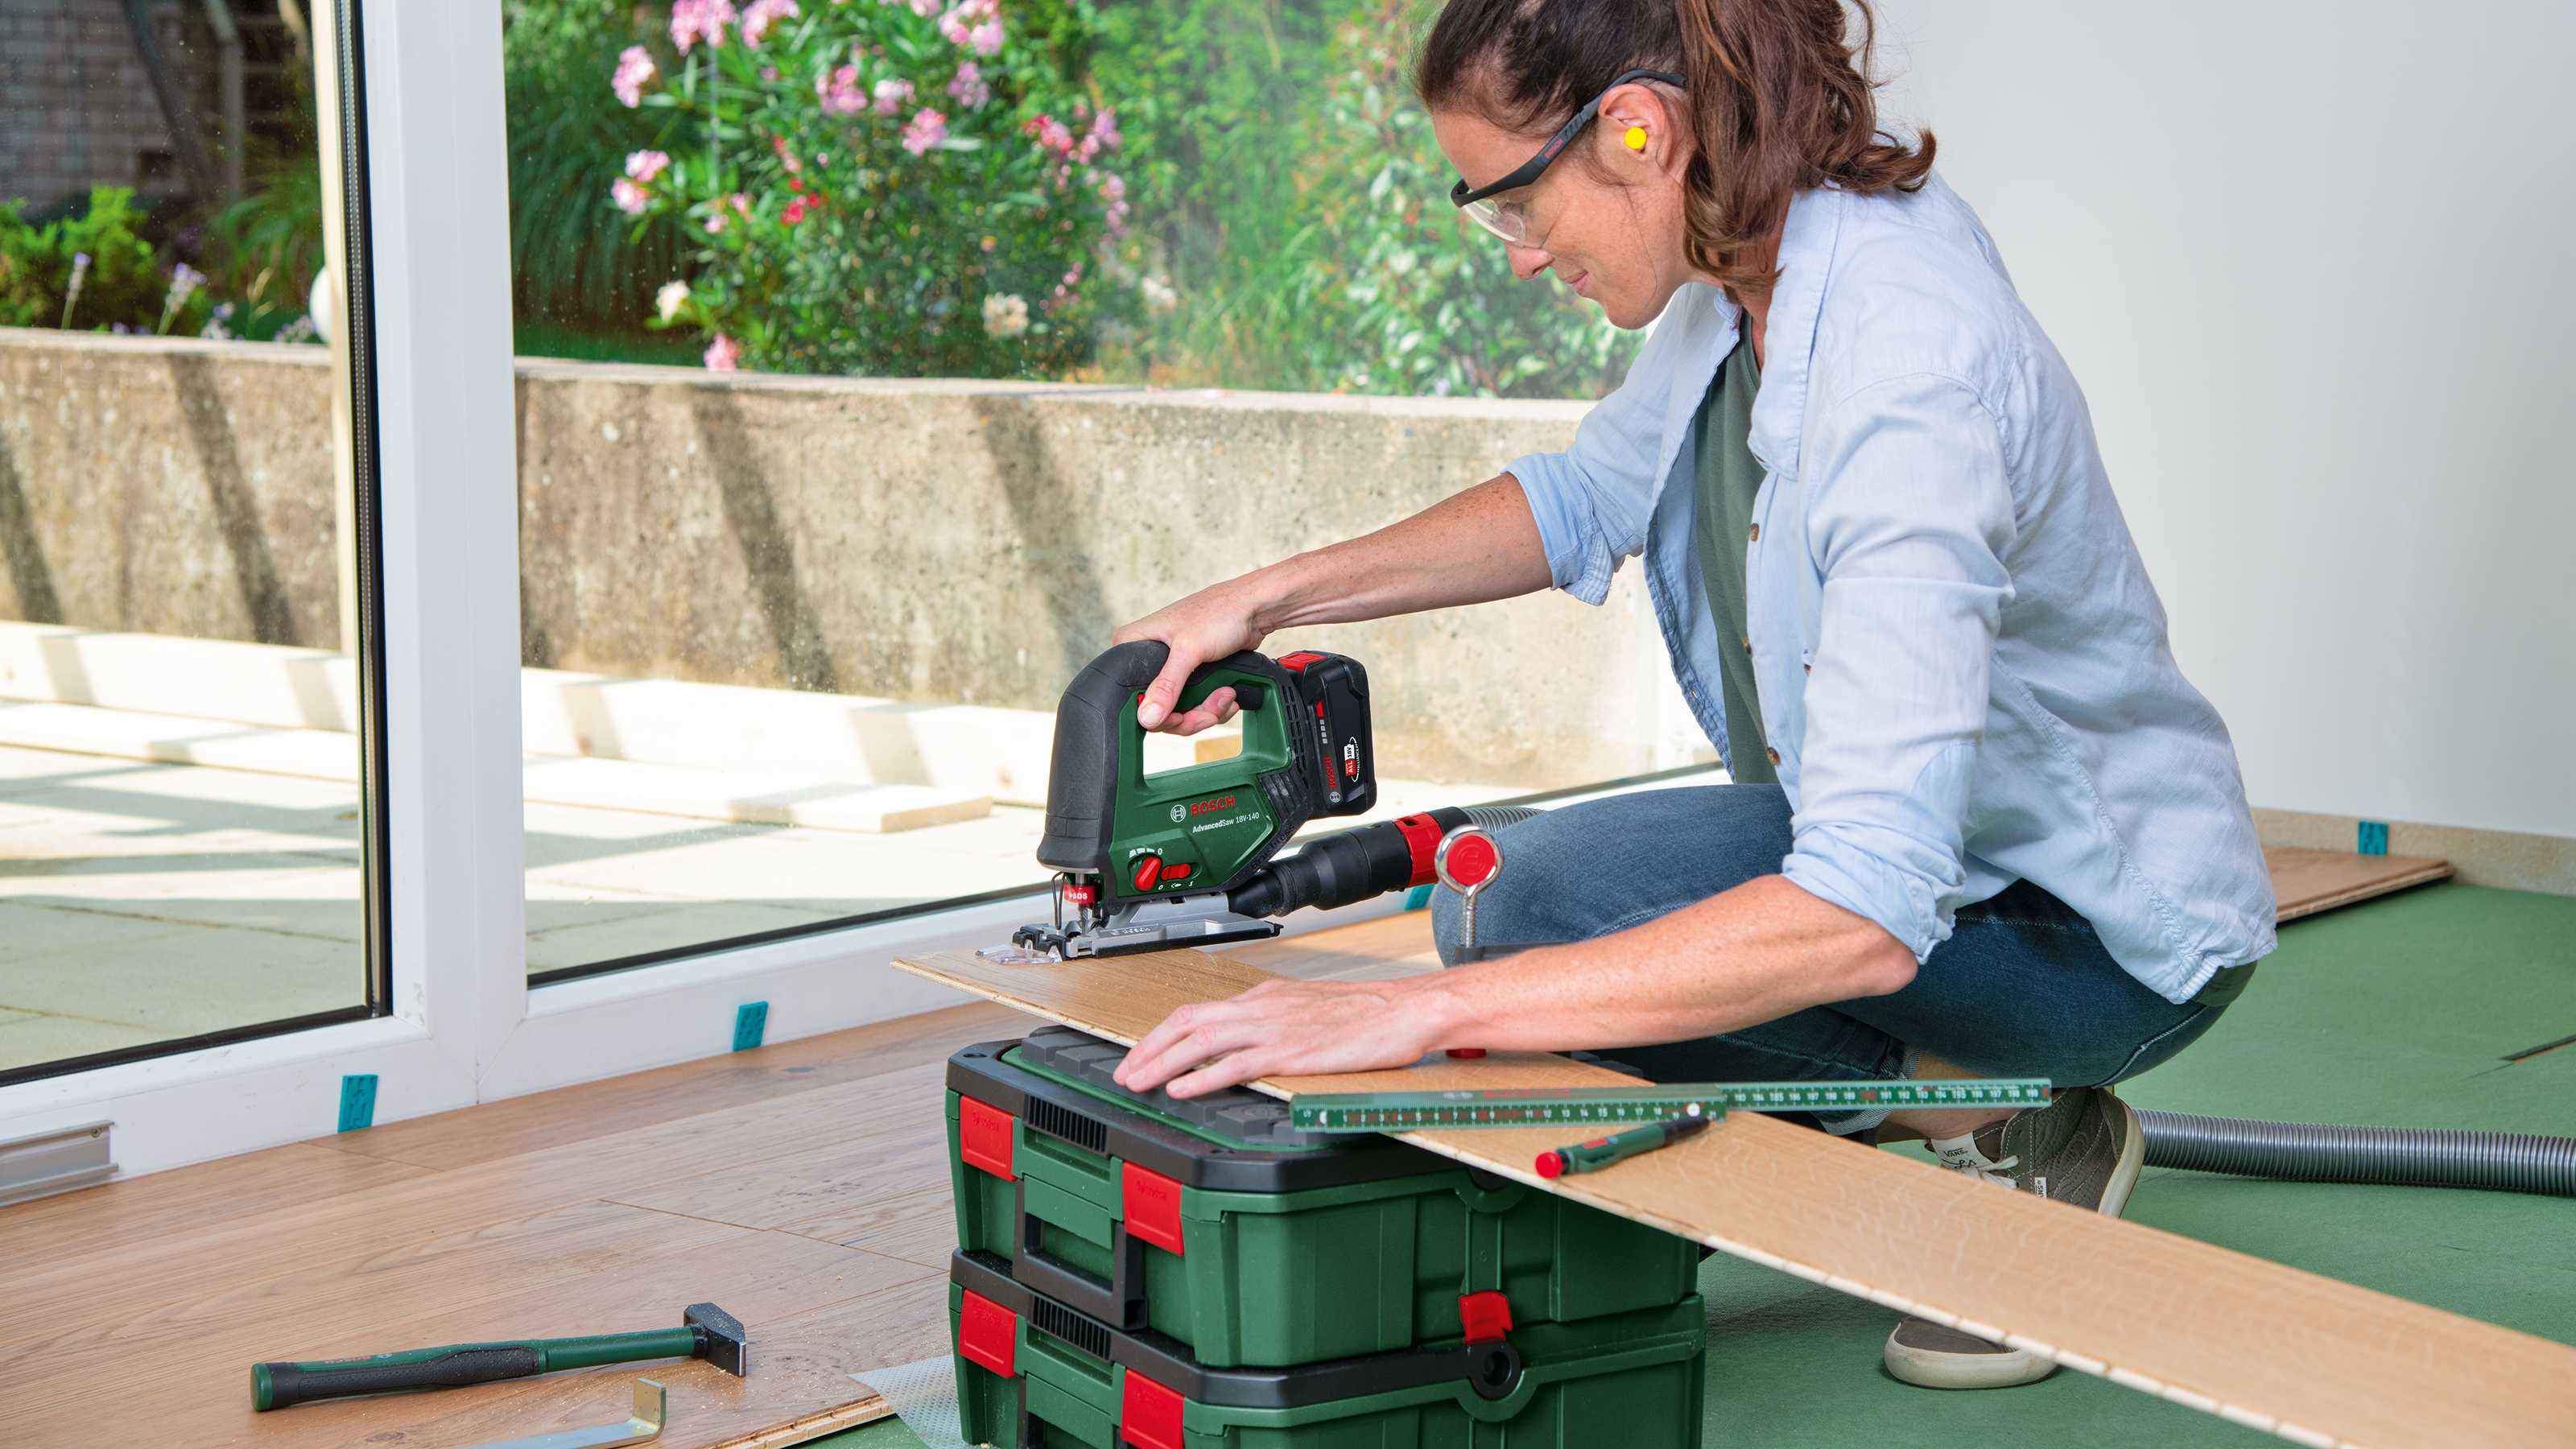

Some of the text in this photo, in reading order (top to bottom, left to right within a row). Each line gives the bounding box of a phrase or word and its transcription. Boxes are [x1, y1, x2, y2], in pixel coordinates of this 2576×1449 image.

[1324, 757, 1337, 788] BOSCH
[1191, 795, 1235, 816] BOSCH
[1192, 819, 1234, 833] AdvancedSaw
[1250, 824, 1295, 869] Brushless
[1072, 892, 1088, 900] SDS
[1860, 1090, 1876, 1101] 190
[1880, 1091, 1892, 1100] 191
[1898, 1090, 1910, 1100] 192
[1917, 1090, 1929, 1099] 193
[1934, 1090, 1946, 1099] 194
[1952, 1089, 1967, 1100] 195
[1971, 1089, 1984, 1098] 196
[1989, 1089, 2002, 1098] 197
[2008, 1088, 2020, 1098] 198
[2026, 1088, 2038, 1098] 199
[1360, 1113, 1366, 1123] 2
[1379, 1113, 1384, 1122] 3
[1397, 1113, 1402, 1121] 4
[1416, 1112, 1422, 1122] 5
[1434, 1112, 1439, 1121] 6
[1453, 1112, 1458, 1120] 7
[1471, 1111, 1476, 1120] 8
[1489, 1111, 1494, 1120] 9
[1525, 1109, 1533, 1118] 11
[1543, 1108, 1552, 1118] 12
[1562, 1108, 1571, 1118] 13
[1579, 1108, 1588, 1117] 14
[1598, 1107, 1608, 1118] 15
[1635, 1107, 1644, 1116] 17
[1653, 1106, 1662, 1116] 18
[1942, 1147, 1964, 1158] VANS
